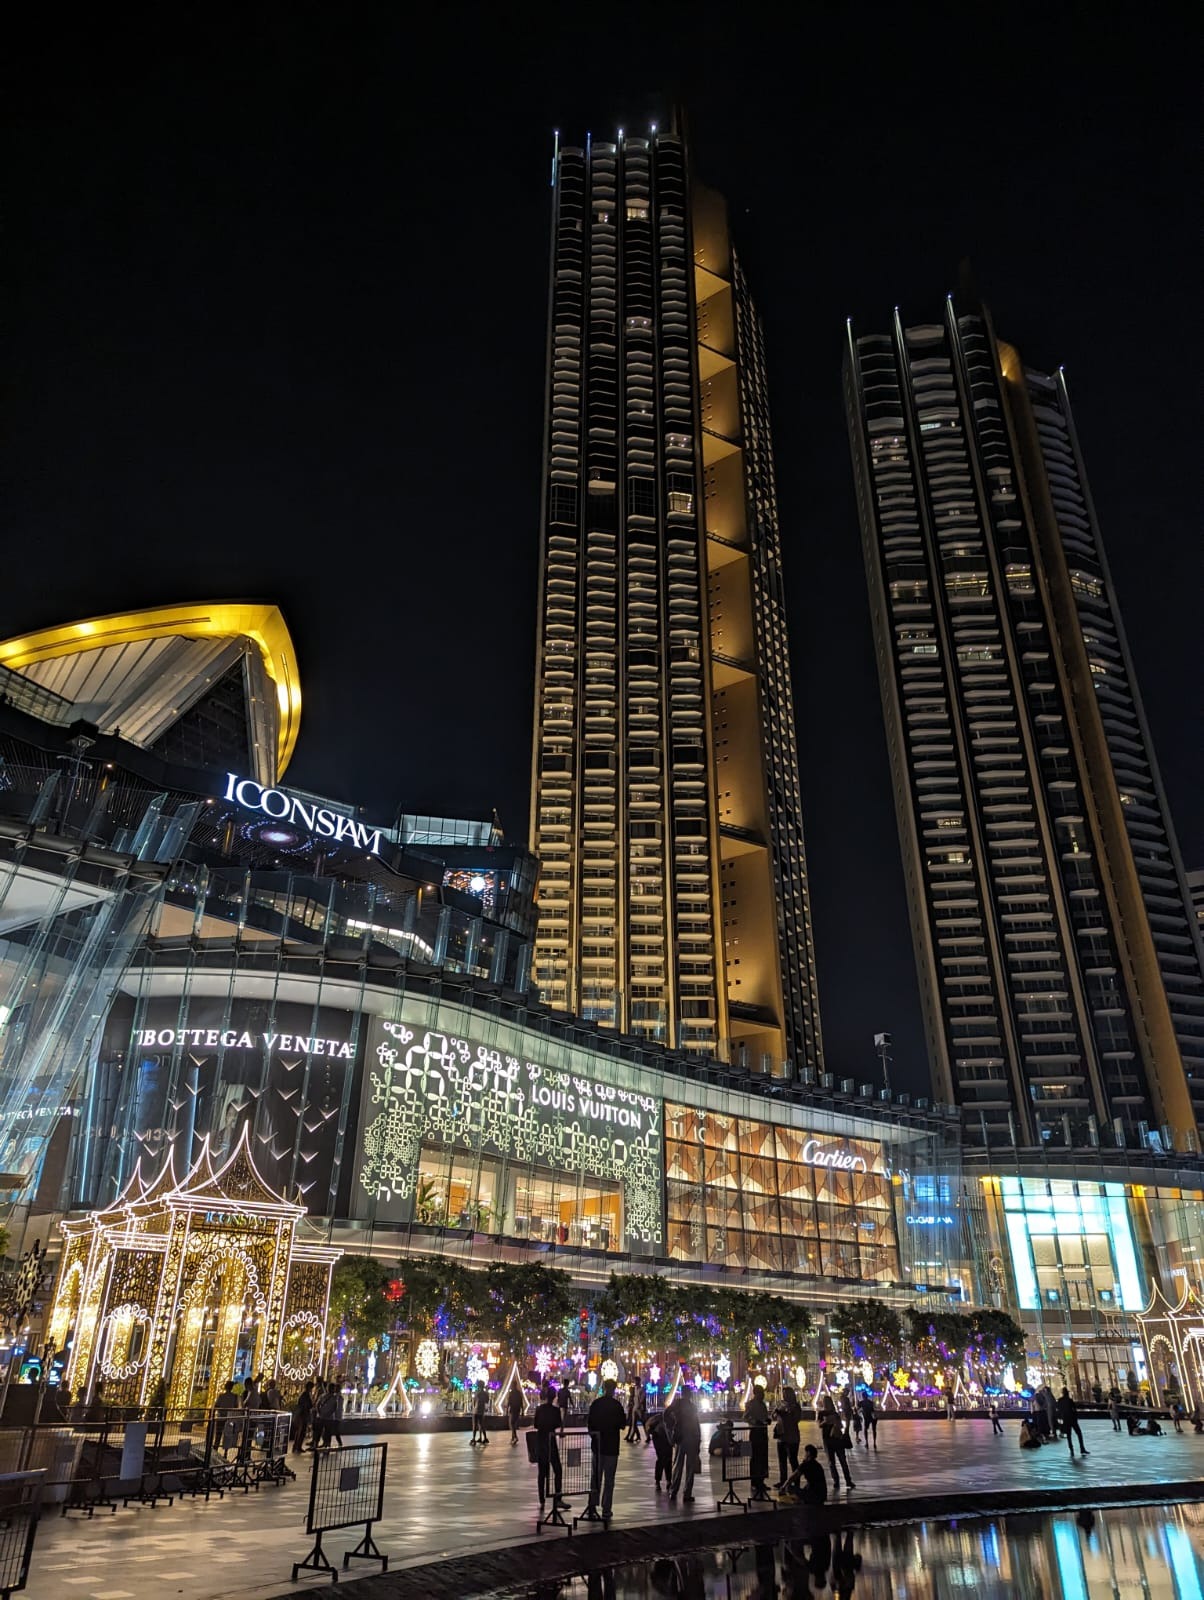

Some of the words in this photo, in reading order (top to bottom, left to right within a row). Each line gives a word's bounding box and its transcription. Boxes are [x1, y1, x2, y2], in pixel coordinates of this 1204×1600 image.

[224, 772, 383, 855] ICONSIAM
[142, 1029, 254, 1048] BOTTEGA
[263, 1032, 352, 1059] VENETA
[532, 1084, 575, 1113] LOUIS
[579, 1097, 641, 1129] VUITTON
[802, 1140, 867, 1173] Cartier
